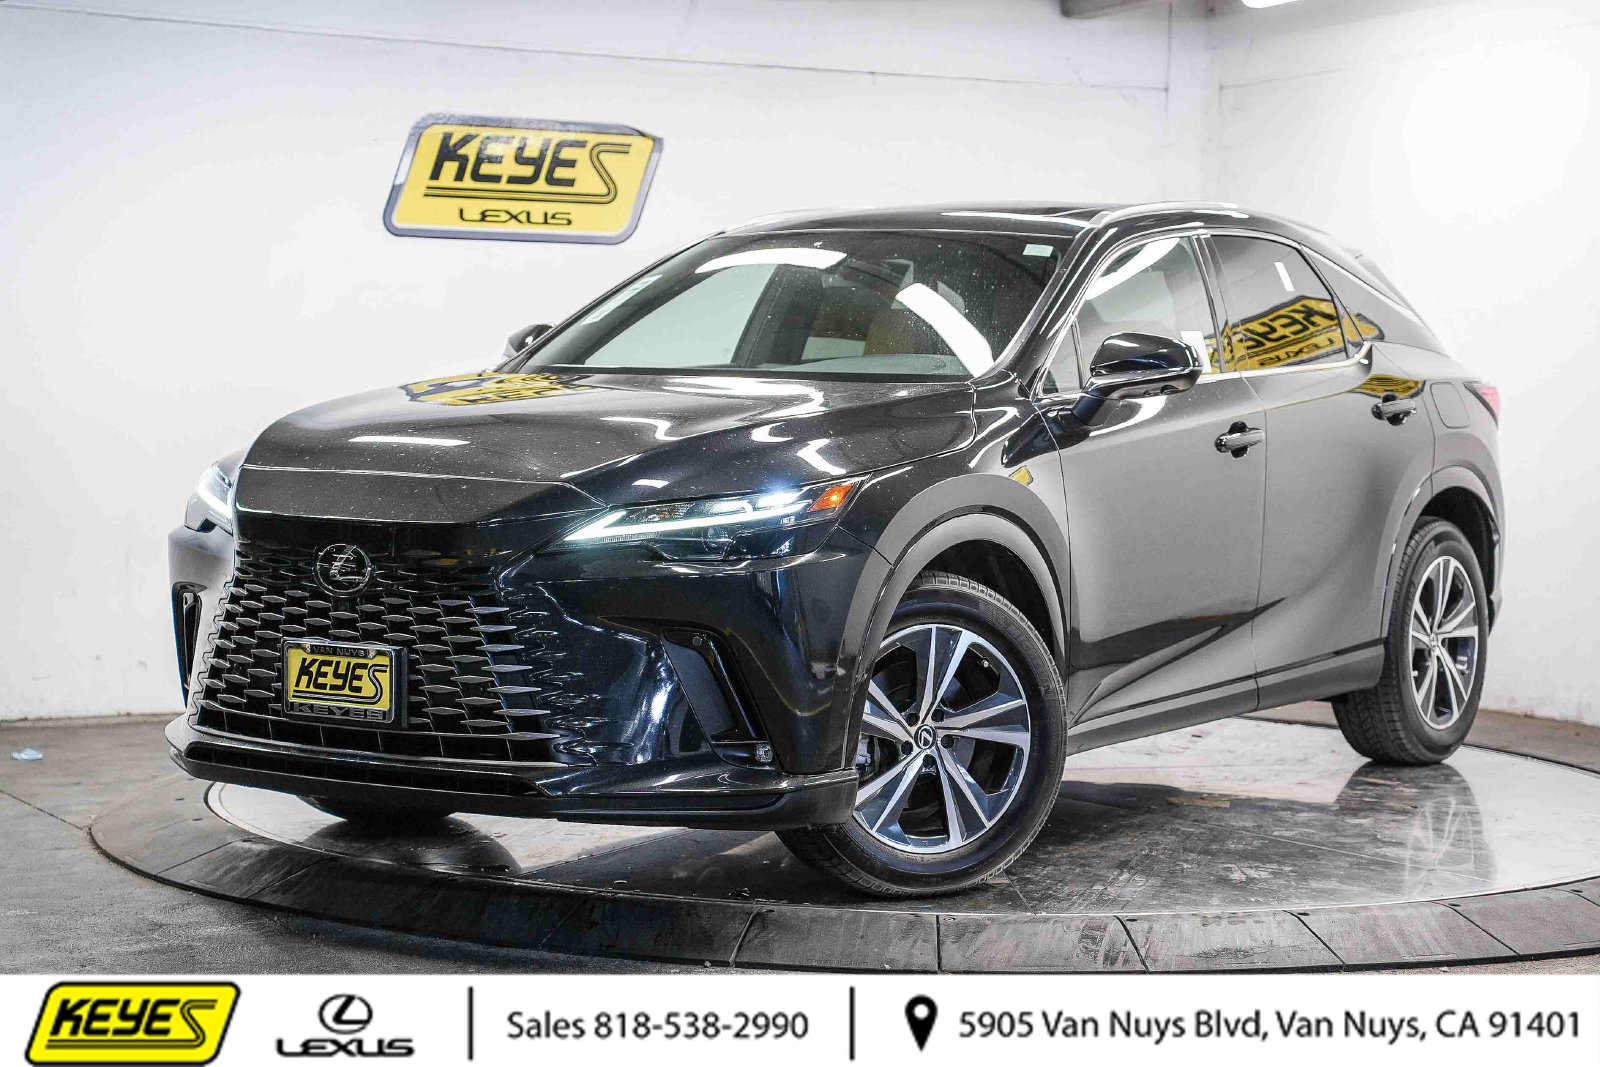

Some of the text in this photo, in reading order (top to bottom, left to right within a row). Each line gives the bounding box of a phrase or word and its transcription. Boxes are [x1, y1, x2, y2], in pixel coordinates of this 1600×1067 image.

[426, 132, 631, 204] KEYES
[459, 208, 572, 226] LEXUS
[313, 646, 366, 657] VAN NUYS
[292, 657, 388, 705] KEYES
[294, 703, 383, 720] KEYES
